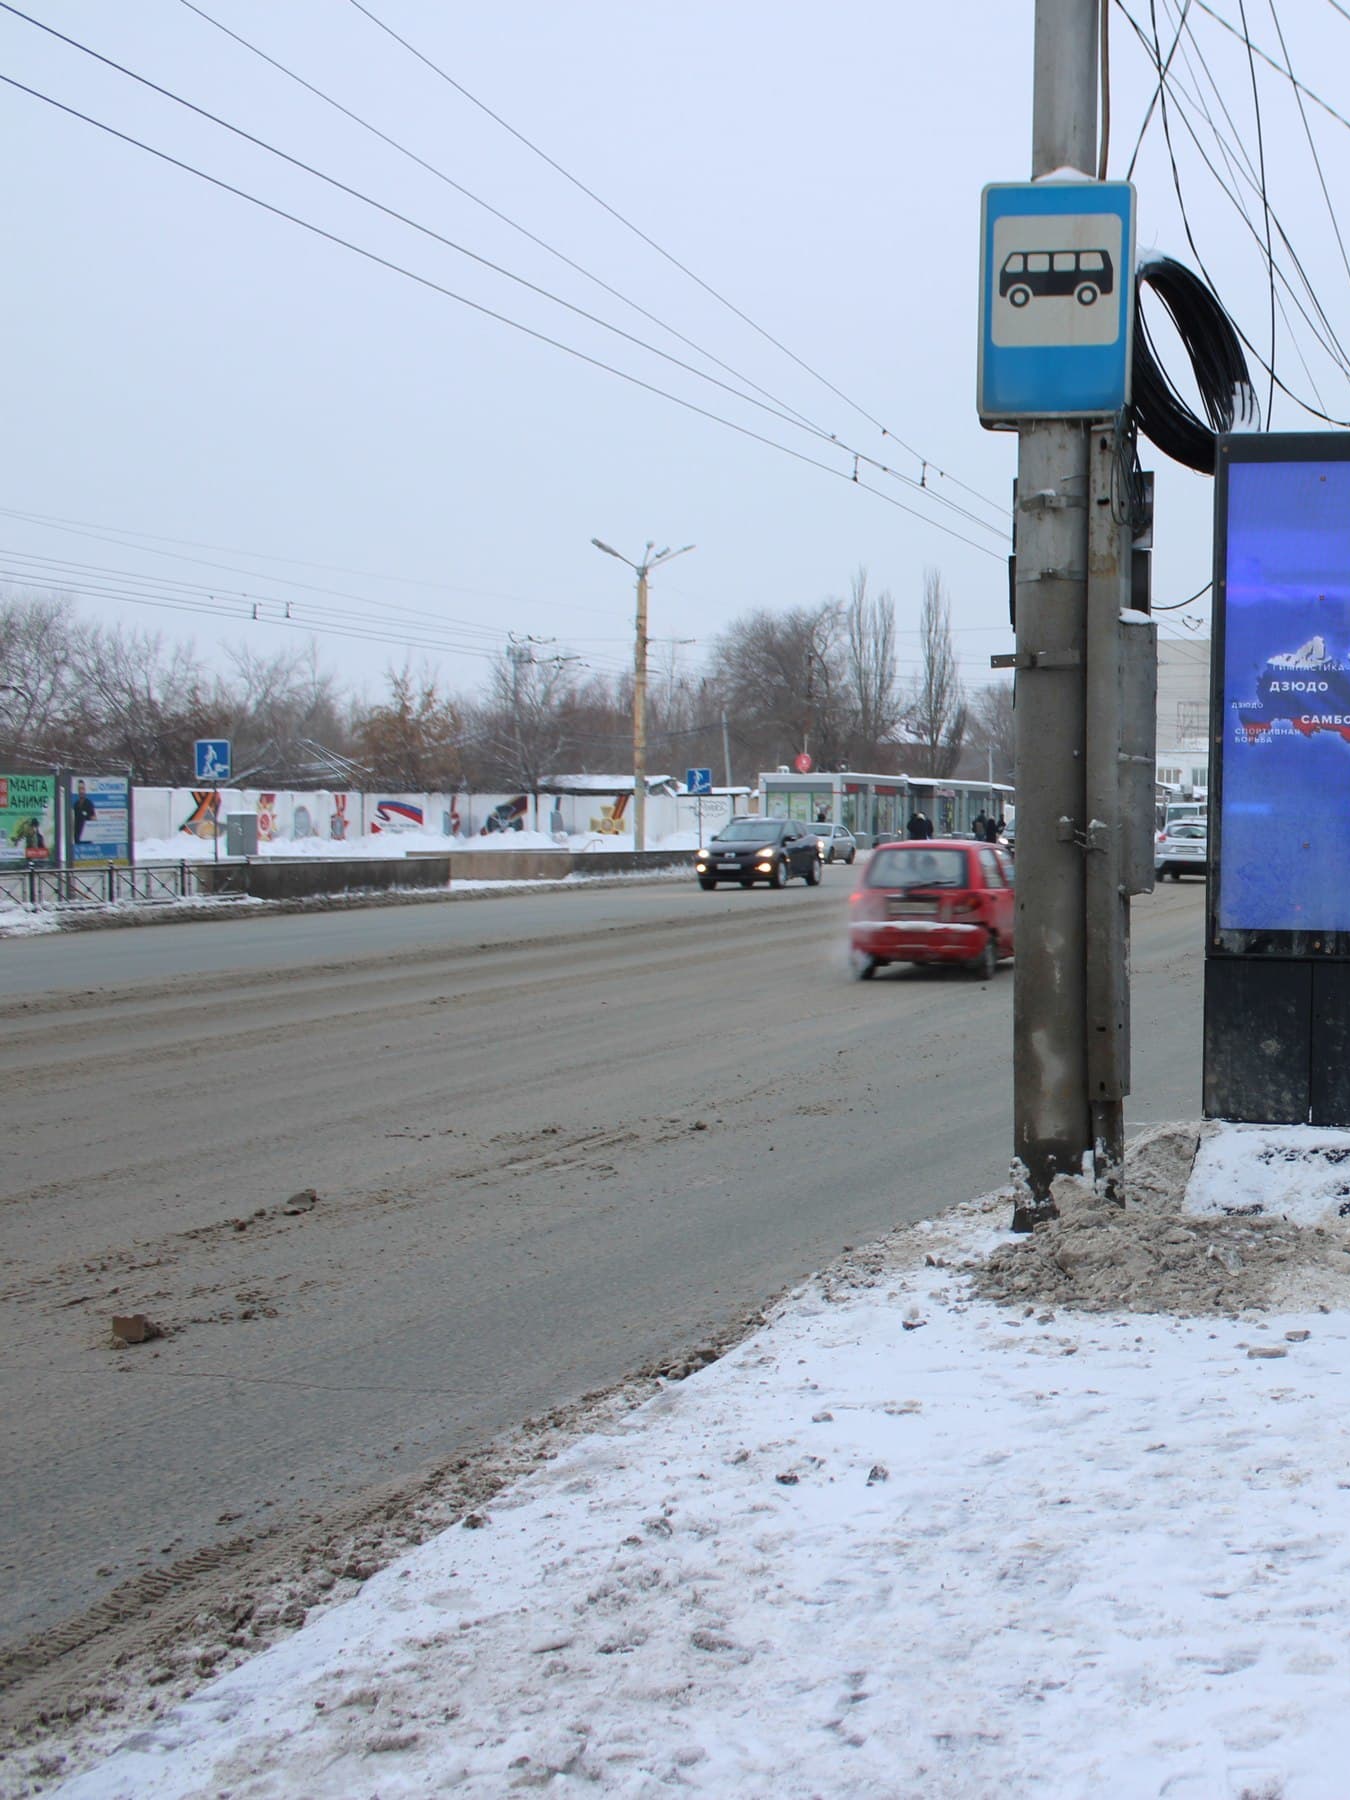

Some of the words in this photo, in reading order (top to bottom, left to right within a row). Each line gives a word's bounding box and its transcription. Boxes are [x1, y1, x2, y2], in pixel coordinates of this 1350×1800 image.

[1269, 681, 1329, 692] ДЗЮДО
[10, 779, 49, 793] МАНГА
[10, 795, 49, 809] АНИМЕ
